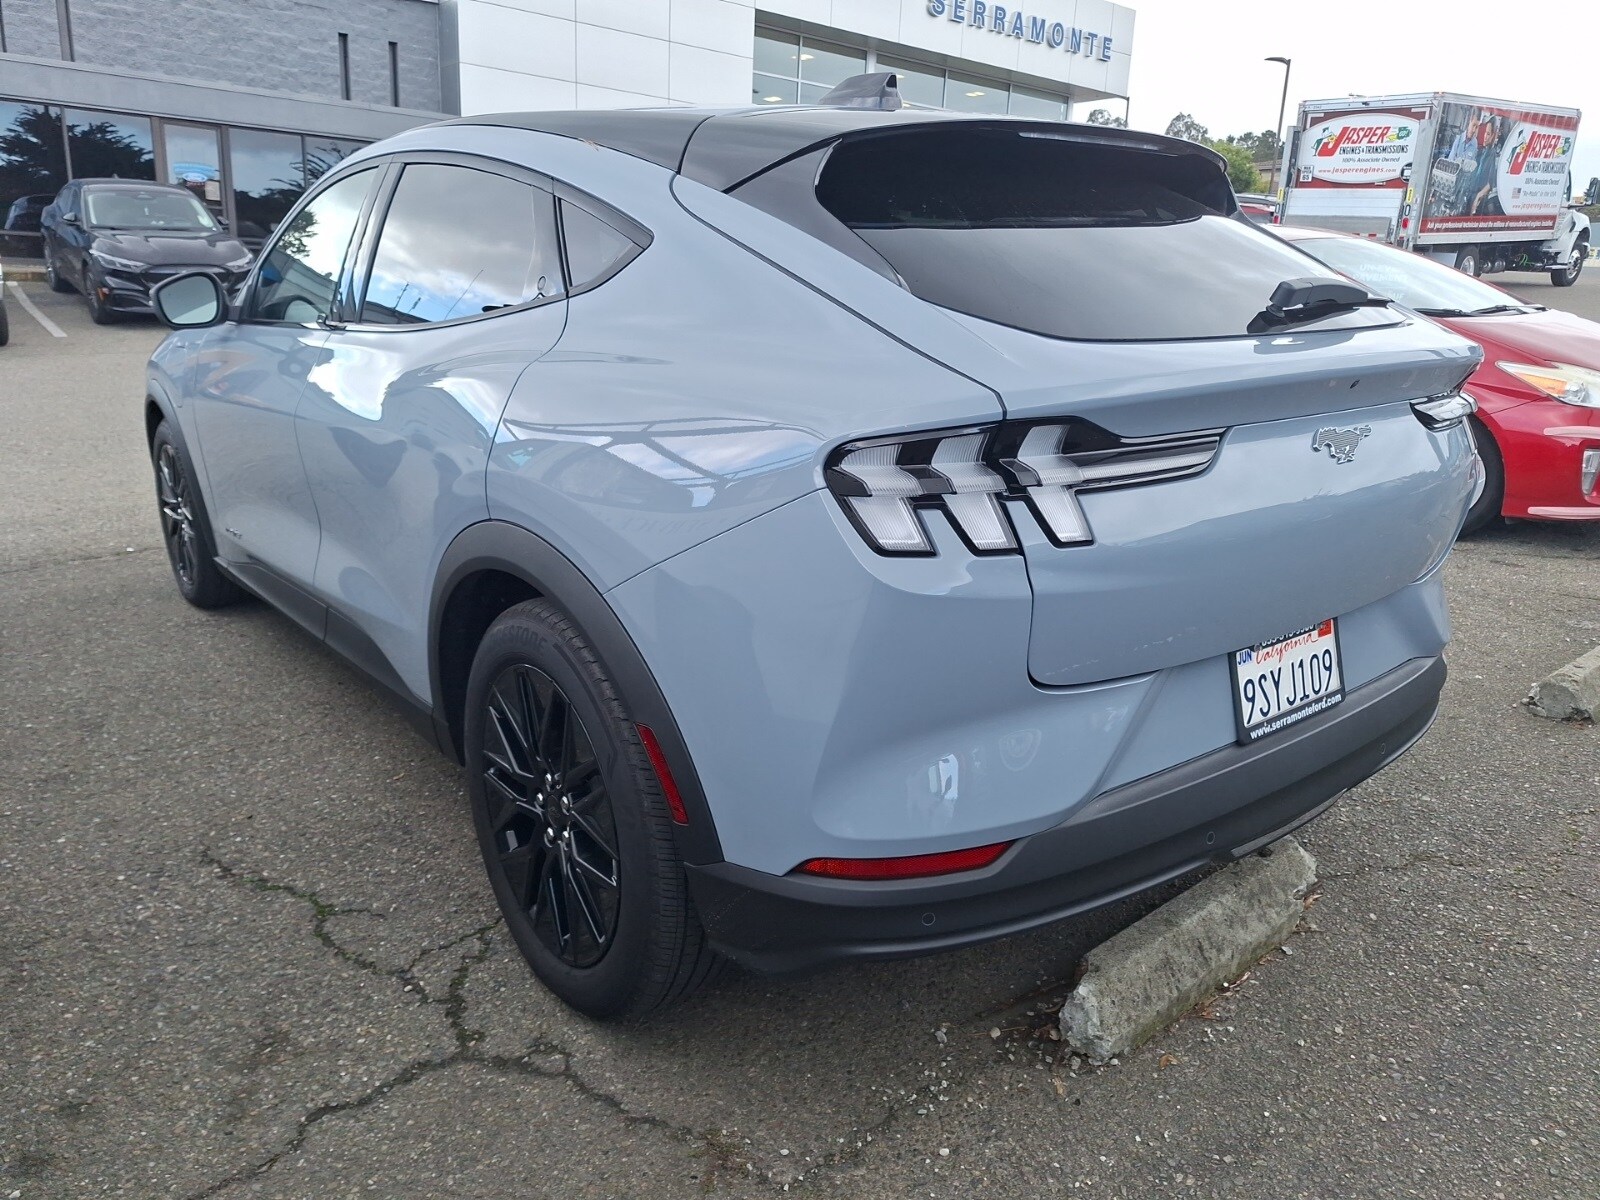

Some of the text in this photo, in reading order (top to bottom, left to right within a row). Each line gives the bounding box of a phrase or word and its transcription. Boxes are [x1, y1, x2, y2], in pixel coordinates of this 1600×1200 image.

[929, 0, 1113, 61] SERRAMONTE
[1317, 126, 1391, 157] JASPER
[1339, 146, 1362, 155] ENGINES
[1365, 145, 1409, 155] TRANSMISSIONS
[1510, 131, 1561, 175] JASPER
[1318, 166, 1396, 175] www.jasperengines.com
[1427, 221, 1435, 229] Ask
[1434, 222, 1443, 230] your
[1442, 221, 1463, 230] professional
[1238, 650, 1252, 665] JUN
[1255, 633, 1318, 665] California
[1243, 649, 1332, 724] 9SYJ109
[1250, 694, 1342, 739] www.serramonteford.com
